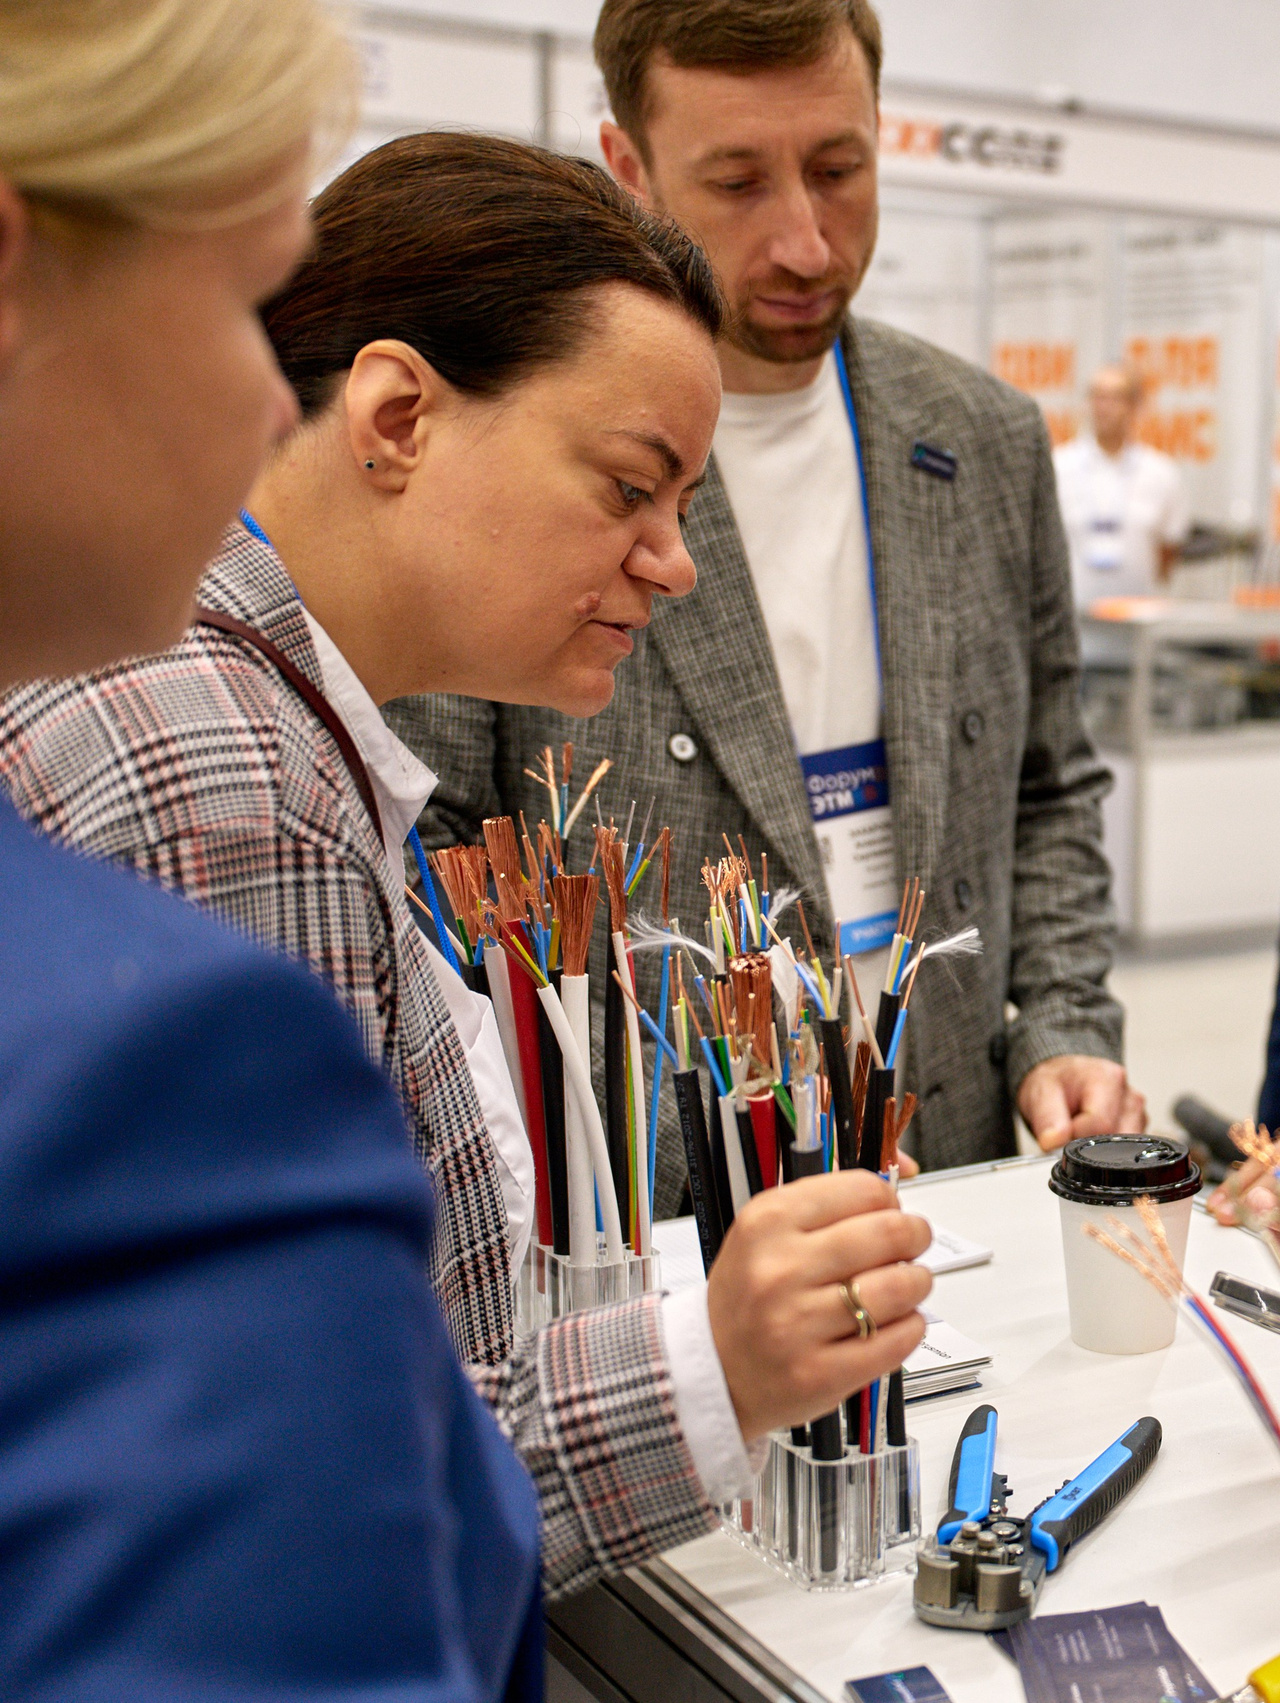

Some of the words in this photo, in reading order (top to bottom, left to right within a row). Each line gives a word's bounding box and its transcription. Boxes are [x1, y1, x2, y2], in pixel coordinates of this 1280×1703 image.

[808, 766, 875, 794] Форум
[810, 789, 855, 815] ЭТМ
[691, 1173, 701, 1196] ГОСТ
